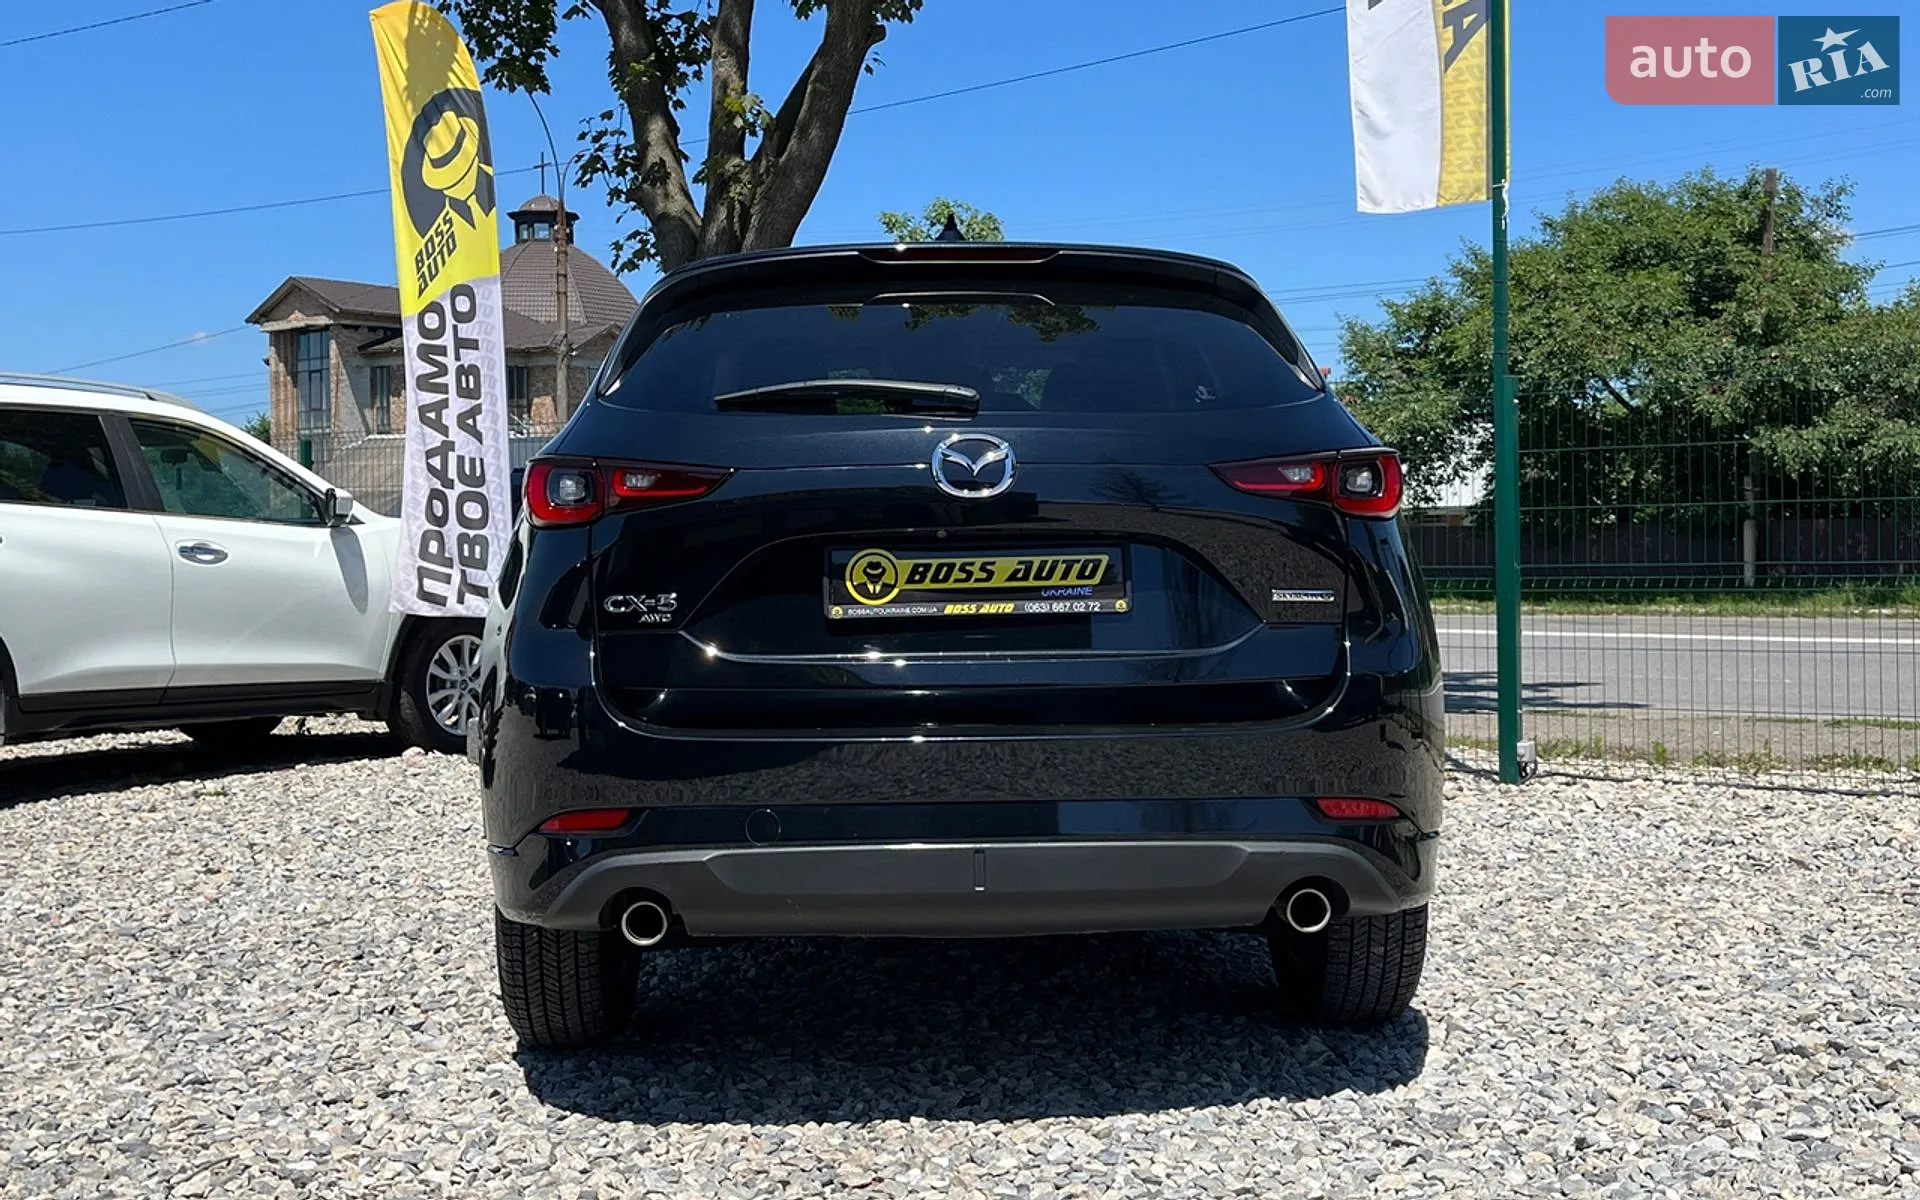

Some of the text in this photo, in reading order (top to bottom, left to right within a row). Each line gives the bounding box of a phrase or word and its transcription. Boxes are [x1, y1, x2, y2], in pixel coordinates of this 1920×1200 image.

[415, 210, 454, 276] BOSS
[417, 230, 457, 299] AUTO
[450, 283, 484, 446] АВТО
[416, 300, 455, 607] ПРОДАМО
[904, 558, 1102, 585] BOSS AUTO
[604, 593, 677, 613] CX-5
[1041, 586, 1093, 597] UKRAINE
[638, 613, 672, 623] AWD
[943, 603, 977, 614] BOSS
[979, 602, 1015, 613] AUTO
[1024, 602, 1050, 613] (063)
[1052, 602, 1071, 613] 667
[1072, 601, 1086, 612] 02
[1088, 601, 1101, 612] 72
